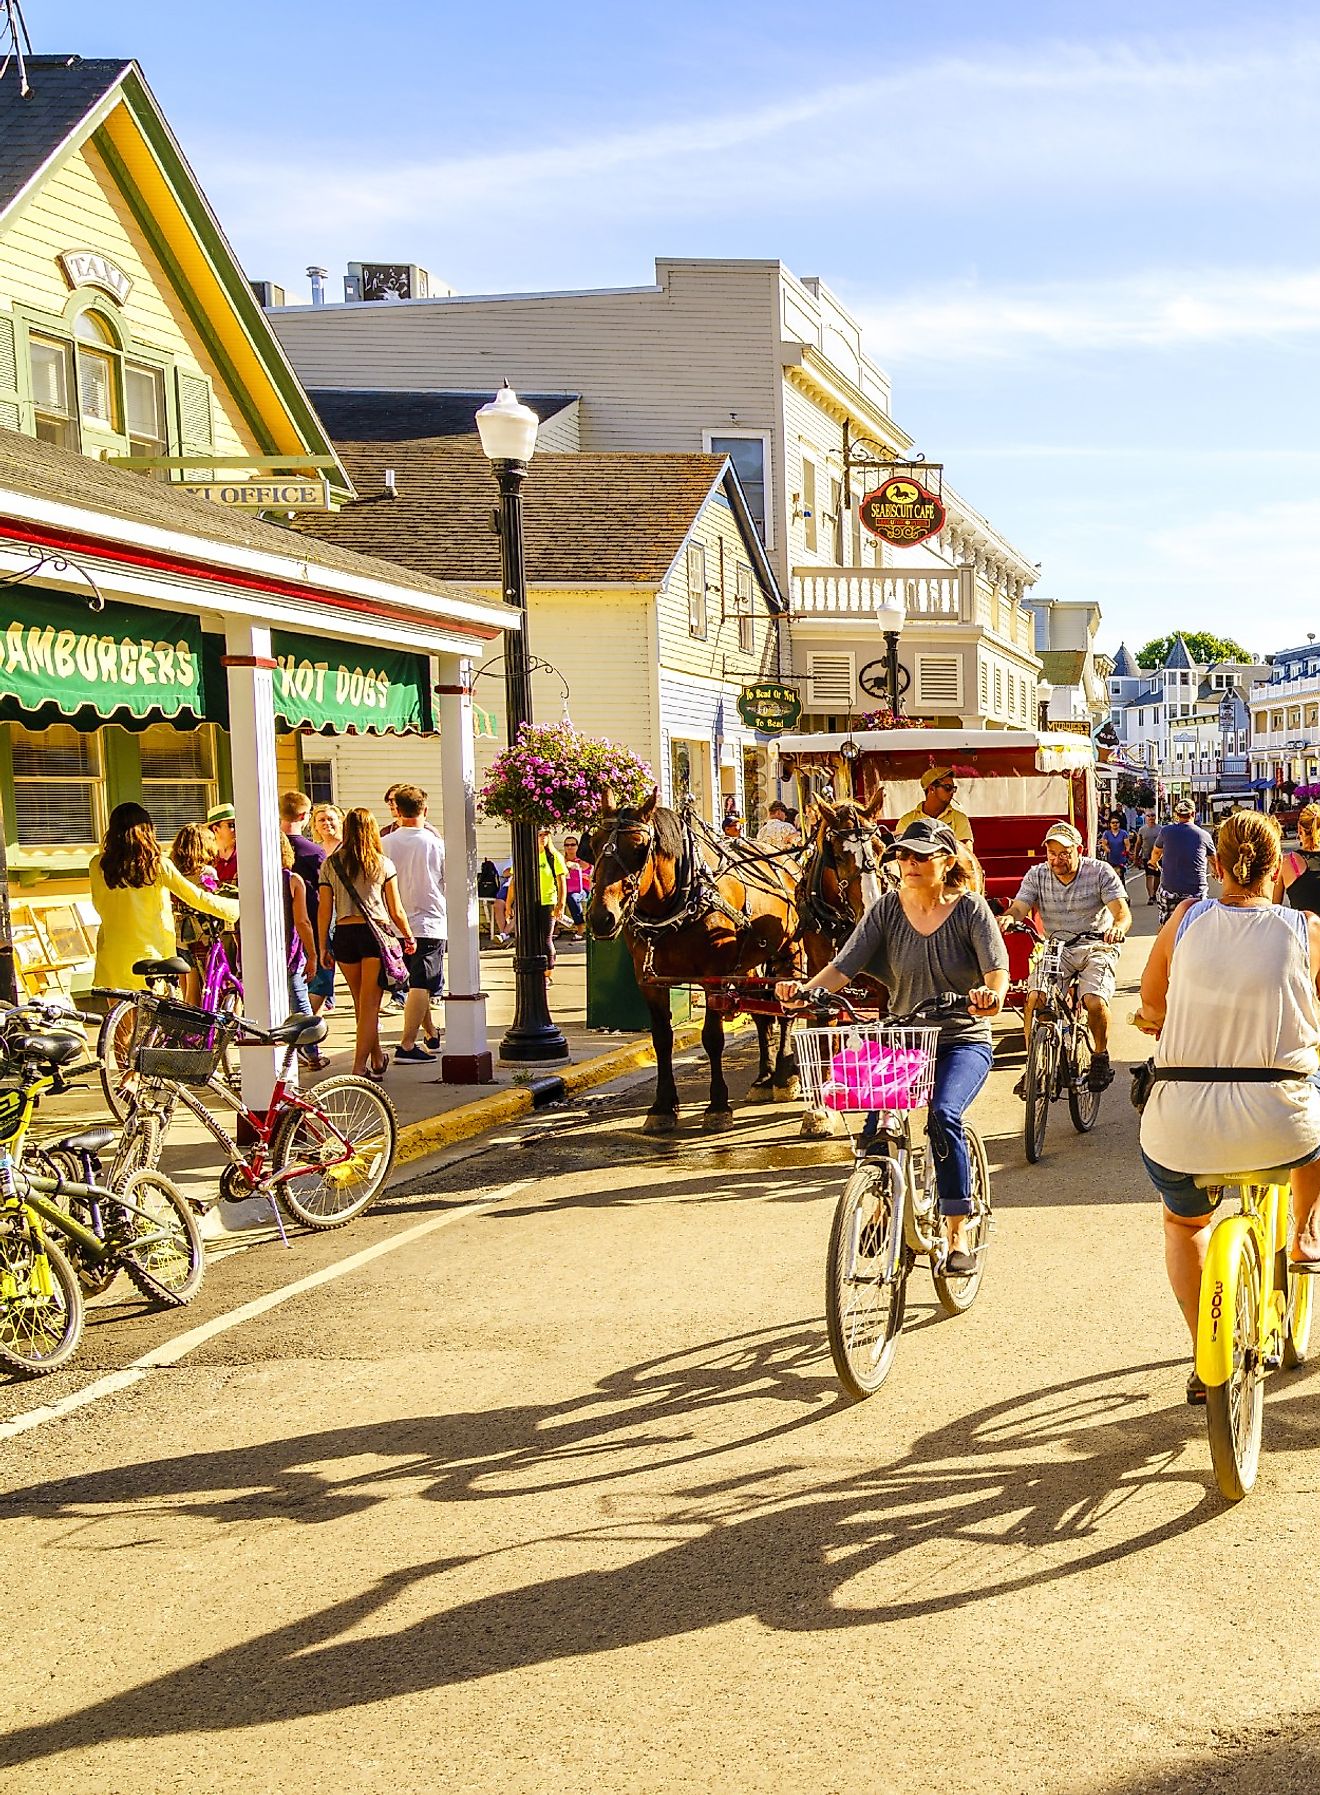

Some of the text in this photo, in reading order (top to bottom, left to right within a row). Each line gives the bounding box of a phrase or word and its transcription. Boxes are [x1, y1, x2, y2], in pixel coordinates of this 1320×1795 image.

[70, 256, 125, 294] TAXI
[220, 486, 318, 504] OFFICE
[871, 503, 913, 518] SEABISCUIT
[0, 620, 195, 687] AMBURGERS
[336, 664, 390, 709] DOGS
[746, 688, 754, 701] To
[773, 689, 782, 700] Or
[756, 717, 765, 727] To
